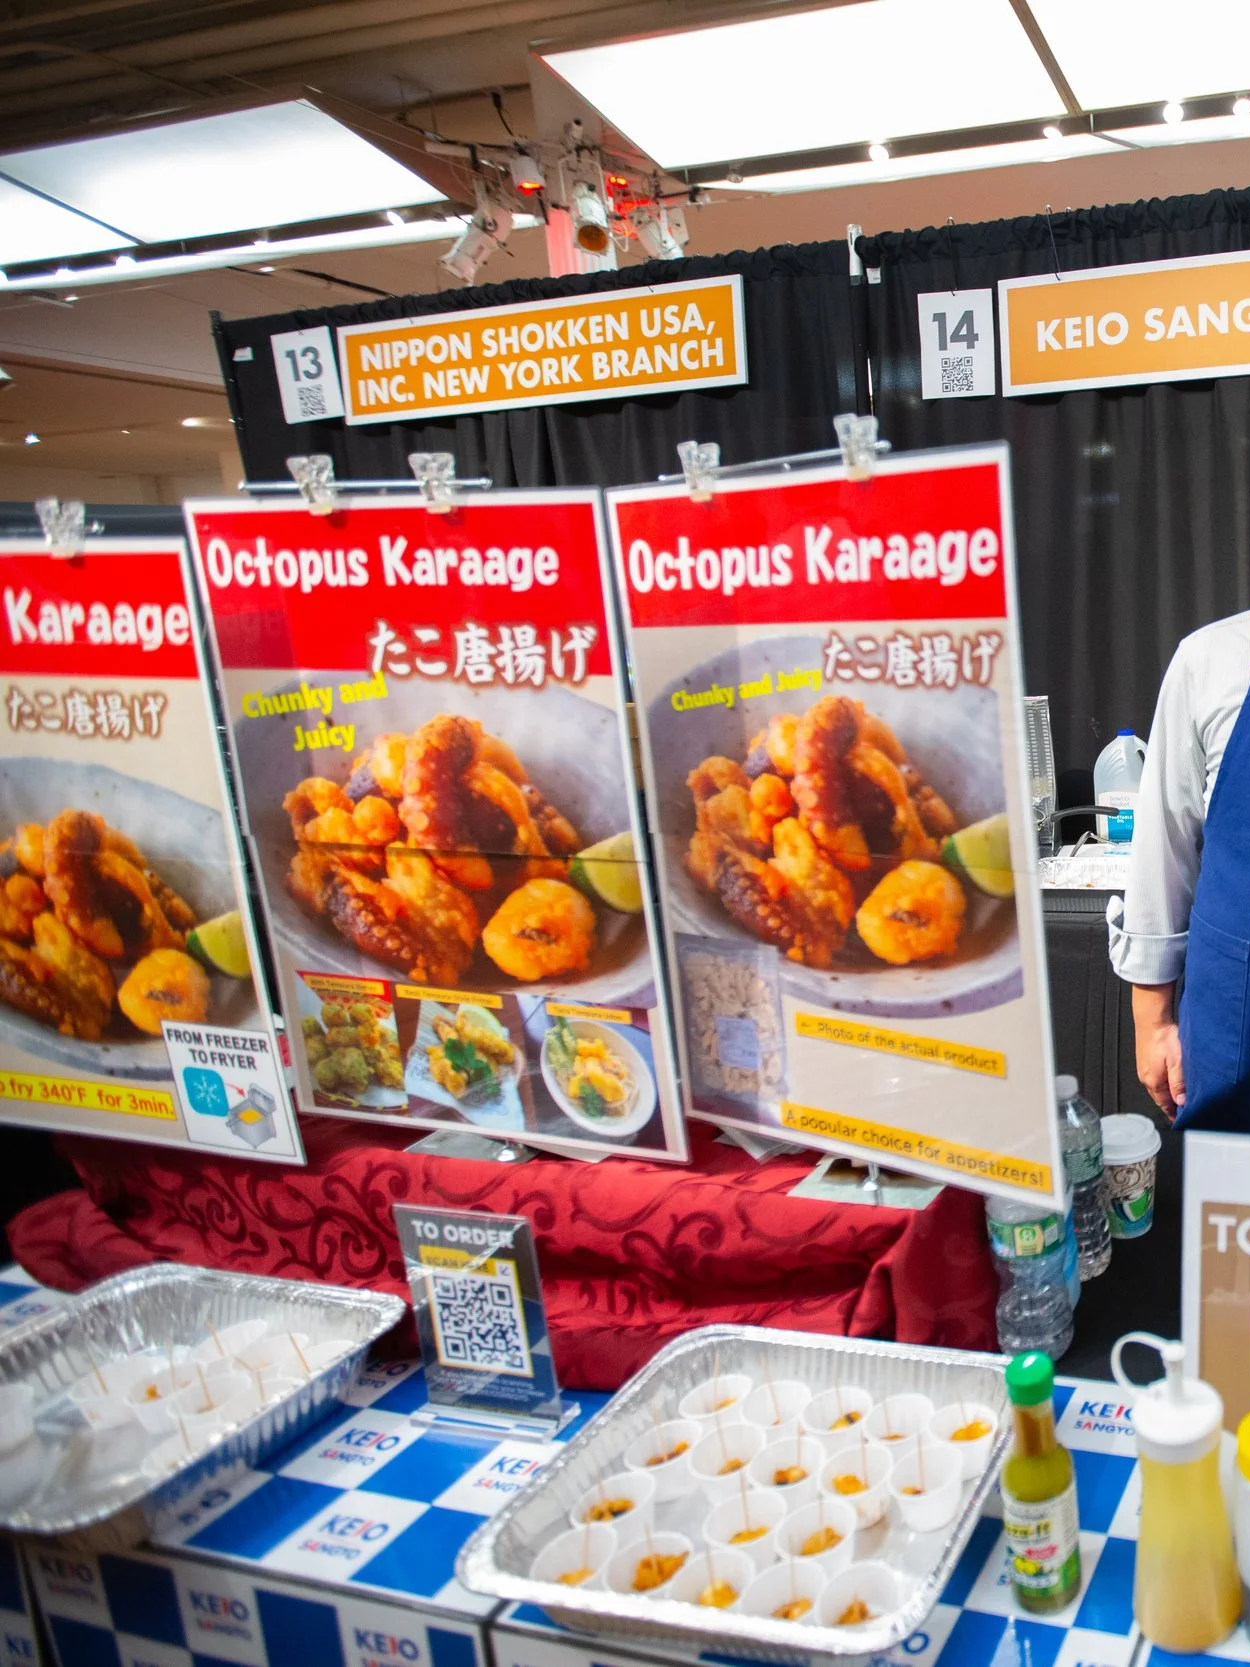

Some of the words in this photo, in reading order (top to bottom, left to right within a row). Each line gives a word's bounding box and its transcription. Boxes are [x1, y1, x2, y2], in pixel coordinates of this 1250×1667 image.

[359, 329, 475, 372] NIPPON
[480, 313, 631, 354] SHOKKEN
[640, 305, 717, 341] USA,
[931, 310, 980, 352] 14
[1036, 311, 1129, 352] KEIO
[284, 345, 324, 382] 13
[357, 374, 415, 405] INC.
[423, 366, 492, 399] NEW
[498, 356, 585, 392] YORK
[592, 338, 726, 380] BRANCH
[206, 536, 369, 593] Octopus
[379, 534, 561, 592] Karaage
[629, 536, 794, 596] Octopus
[804, 525, 999, 586] Karaage
[2, 587, 191, 651] Karaage
[368, 619, 597, 688] たこ唐揚げ
[823, 630, 1001, 690] たこ唐揚げ
[241, 680, 333, 719] Chunky
[338, 670, 388, 703] and
[672, 682, 735, 712] Chunky
[739, 676, 772, 699] and
[777, 667, 821, 692] Juicy
[6, 687, 167, 740] たこ唐揚げ
[293, 720, 357, 753] Juicy
[166, 1028, 203, 1045] FROM
[206, 1032, 268, 1053] FREEZER
[189, 1048, 209, 1064] TO
[211, 1051, 257, 1070] FRYER
[817, 1022, 855, 1041] Photo
[857, 1031, 871, 1044] of
[874, 1032, 897, 1050] the
[900, 1039, 940, 1059] actual
[943, 1048, 999, 1073] product
[10, 1078, 35, 1099] fry
[97, 1088, 122, 1108] for
[128, 1091, 174, 1115] 3min.
[785, 1109, 797, 1123] A
[800, 1112, 857, 1139] popular
[861, 1127, 913, 1154] choice
[917, 1139, 942, 1160] for
[946, 1150, 1044, 1188] appetizers!
[410, 1219, 439, 1240] TO
[443, 1224, 515, 1249] ORDER
[318, 1448, 376, 1467] SANGYO
[336, 1428, 402, 1452] KEIO
[472, 1476, 524, 1493] SANGY
[317, 1513, 391, 1544] KEIO
[297, 1538, 362, 1561] SANGYO
[188, 1589, 249, 1621] KEIO
[354, 1627, 419, 1661] KEIO
